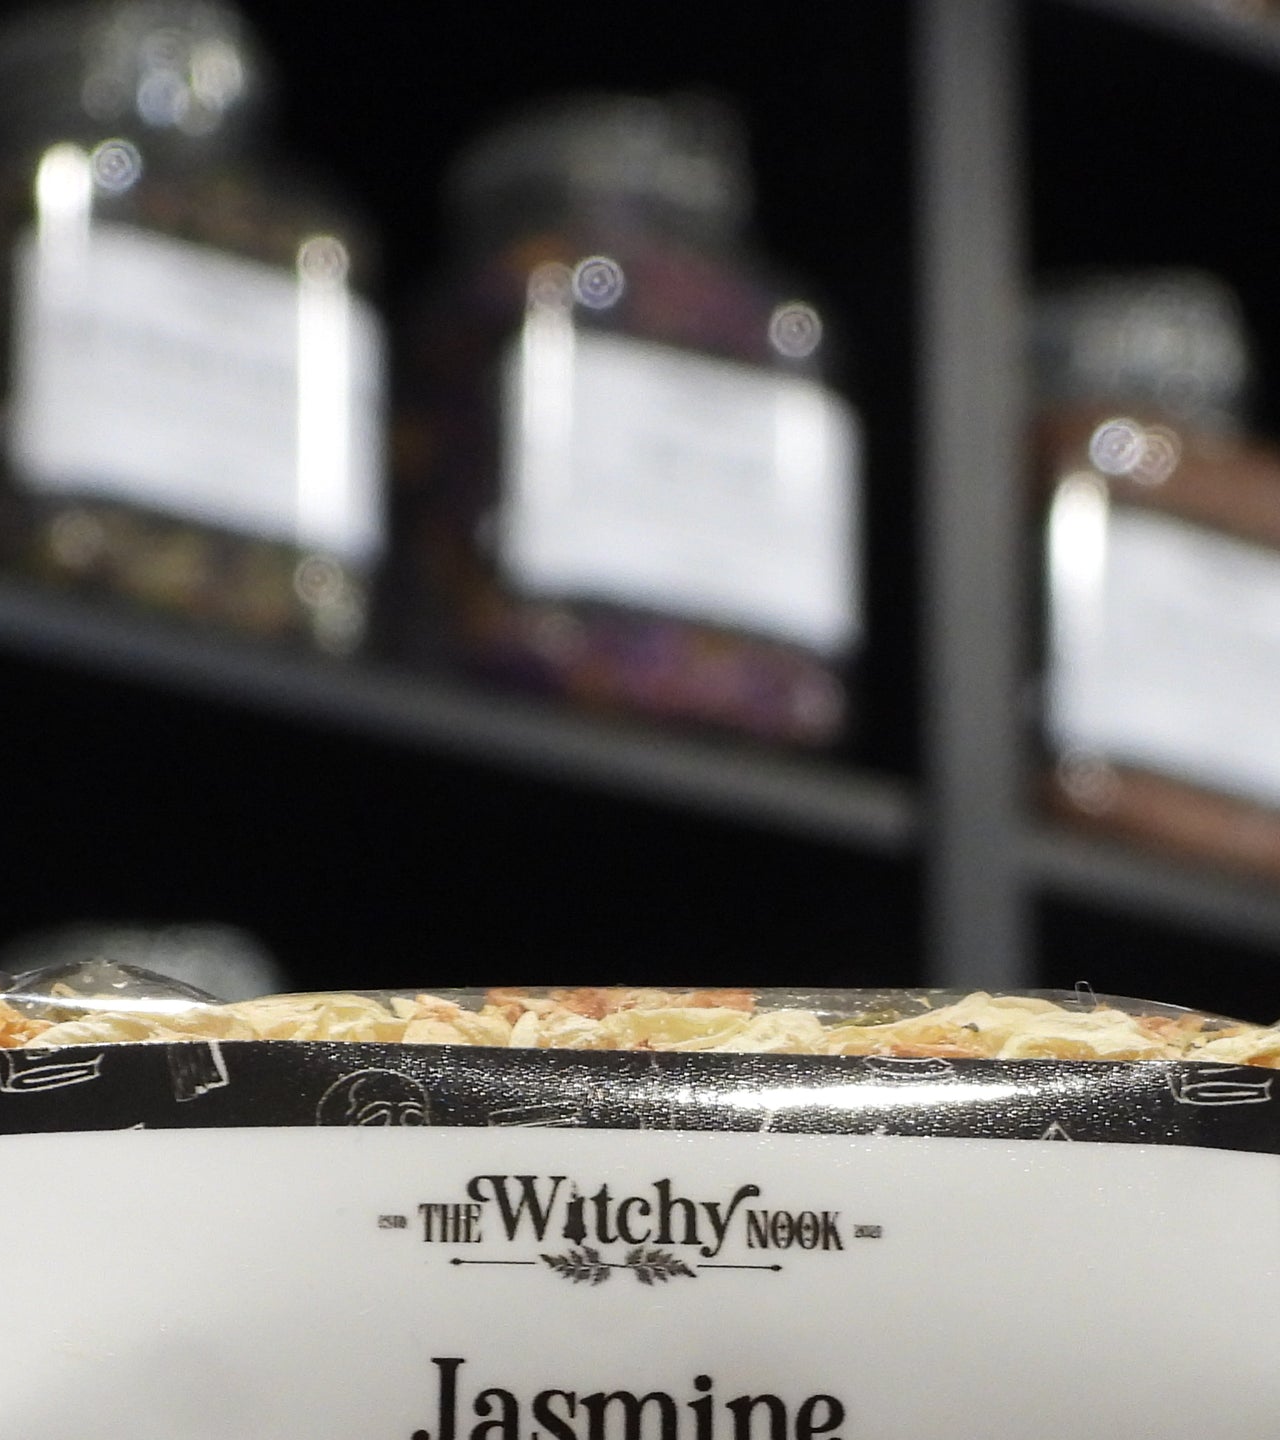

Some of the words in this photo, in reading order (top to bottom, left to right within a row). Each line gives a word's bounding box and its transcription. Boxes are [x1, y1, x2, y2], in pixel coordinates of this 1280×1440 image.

[418, 1202, 483, 1243] THE
[466, 1174, 760, 1258] Witchy
[745, 1209, 844, 1251] NOOK
